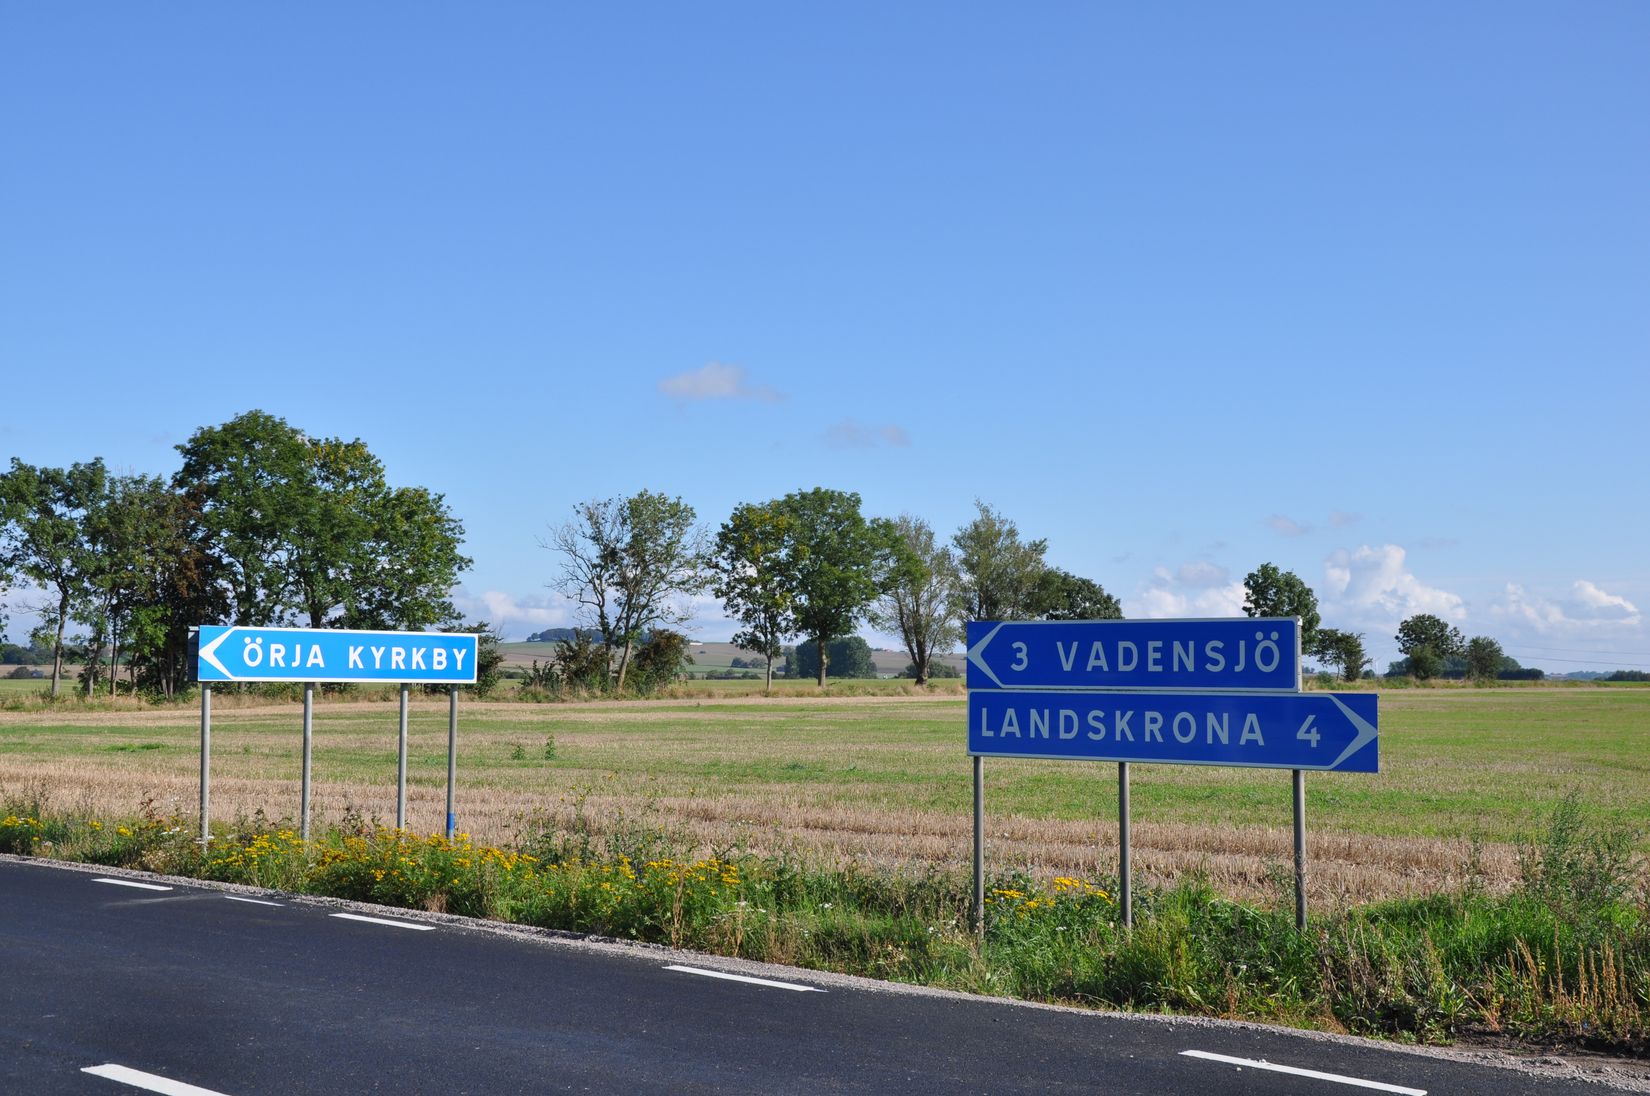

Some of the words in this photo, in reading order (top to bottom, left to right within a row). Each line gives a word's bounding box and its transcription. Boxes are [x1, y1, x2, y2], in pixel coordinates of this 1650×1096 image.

[243, 637, 325, 667] ÖRJA
[349, 645, 467, 670] KYRKBY
[1010, 641, 1028, 672] 3
[1057, 631, 1281, 673] VADENSJÖ
[981, 707, 1265, 746] LANDSKRONA
[1296, 714, 1321, 748] 4
